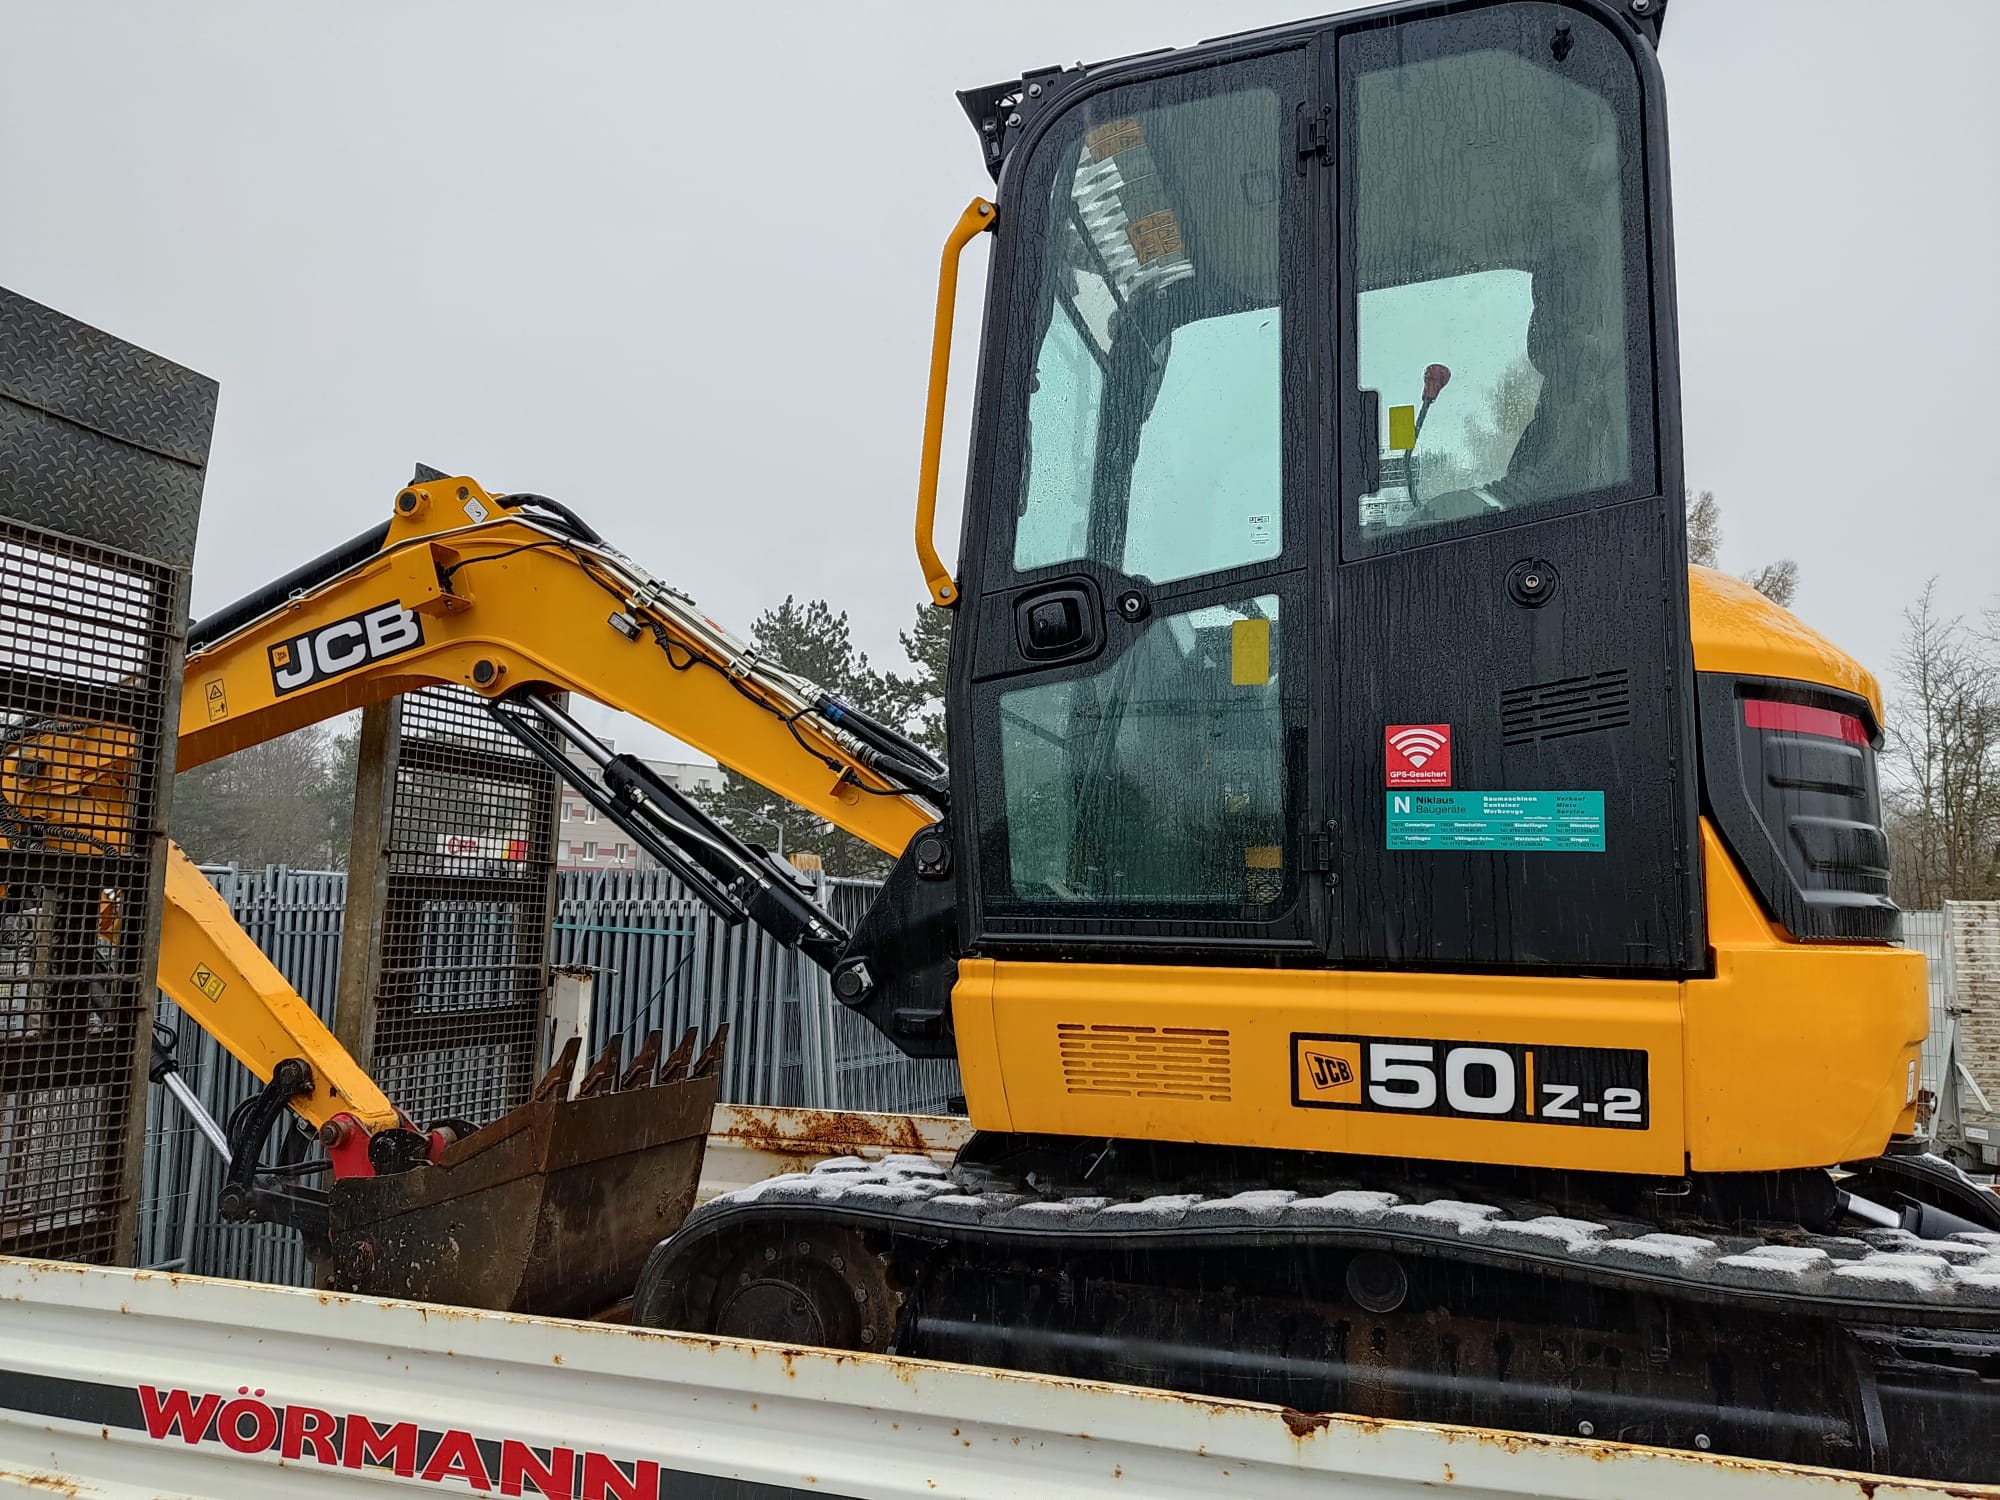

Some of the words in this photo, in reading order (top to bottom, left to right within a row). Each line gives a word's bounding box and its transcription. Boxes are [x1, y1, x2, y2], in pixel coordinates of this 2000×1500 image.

[276, 604, 419, 689] JCB
[1390, 770, 1447, 778] GPS-Gesichert
[1394, 796, 1410, 813] N
[1416, 796, 1455, 804] Niklaus
[1314, 1056, 1350, 1086] JCB
[1369, 1043, 1516, 1114] 50
[1542, 1083, 1642, 1123] Z-2
[137, 1385, 660, 1500] WÖRMANN
